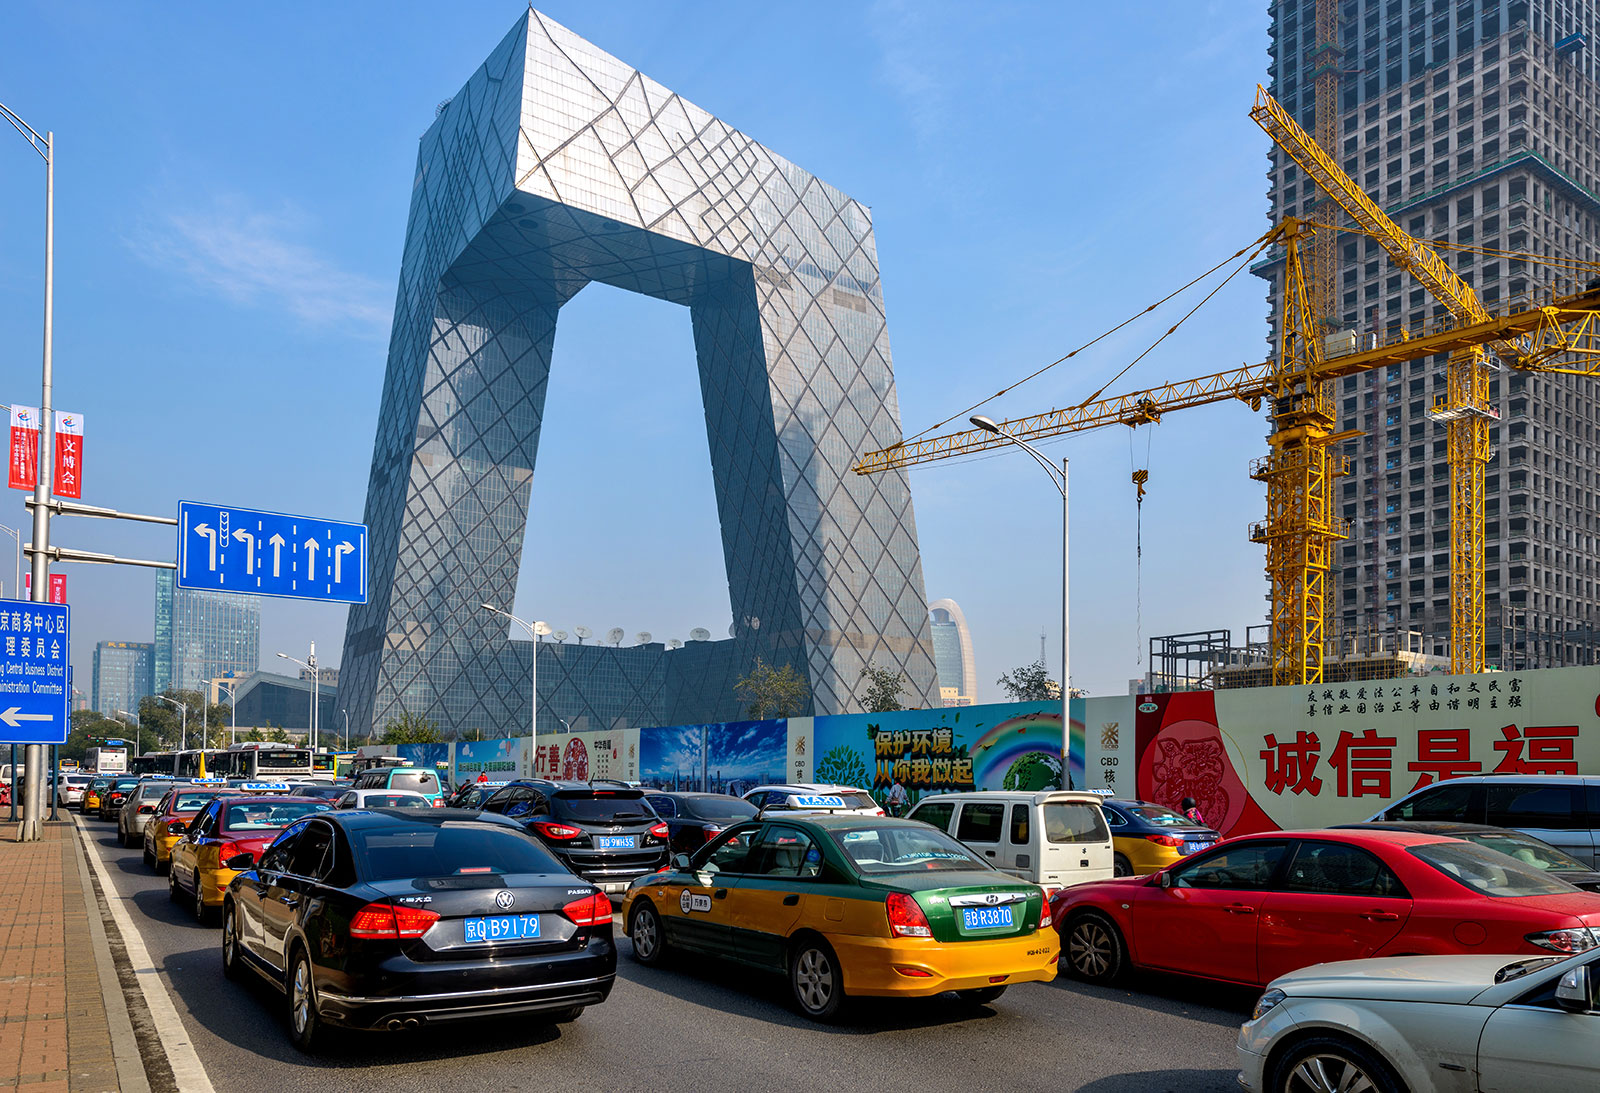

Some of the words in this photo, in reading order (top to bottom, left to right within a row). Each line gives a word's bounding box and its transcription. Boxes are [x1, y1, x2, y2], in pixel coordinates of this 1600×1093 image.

[62, 439, 76, 485] 文博会
[0, 609, 65, 634] 京商务中心区
[5, 636, 60, 659] 理委员会
[6, 661, 23, 675] Central
[25, 662, 45, 676] Business
[47, 663, 63, 677] District
[32, 680, 63, 695] Committee
[875, 728, 952, 756] 保护环境
[874, 757, 973, 784] 从你我做起
[1101, 757, 1119, 766] CBD
[1260, 724, 1580, 798] 诚信是福
[798, 796, 842, 804] TAXI
